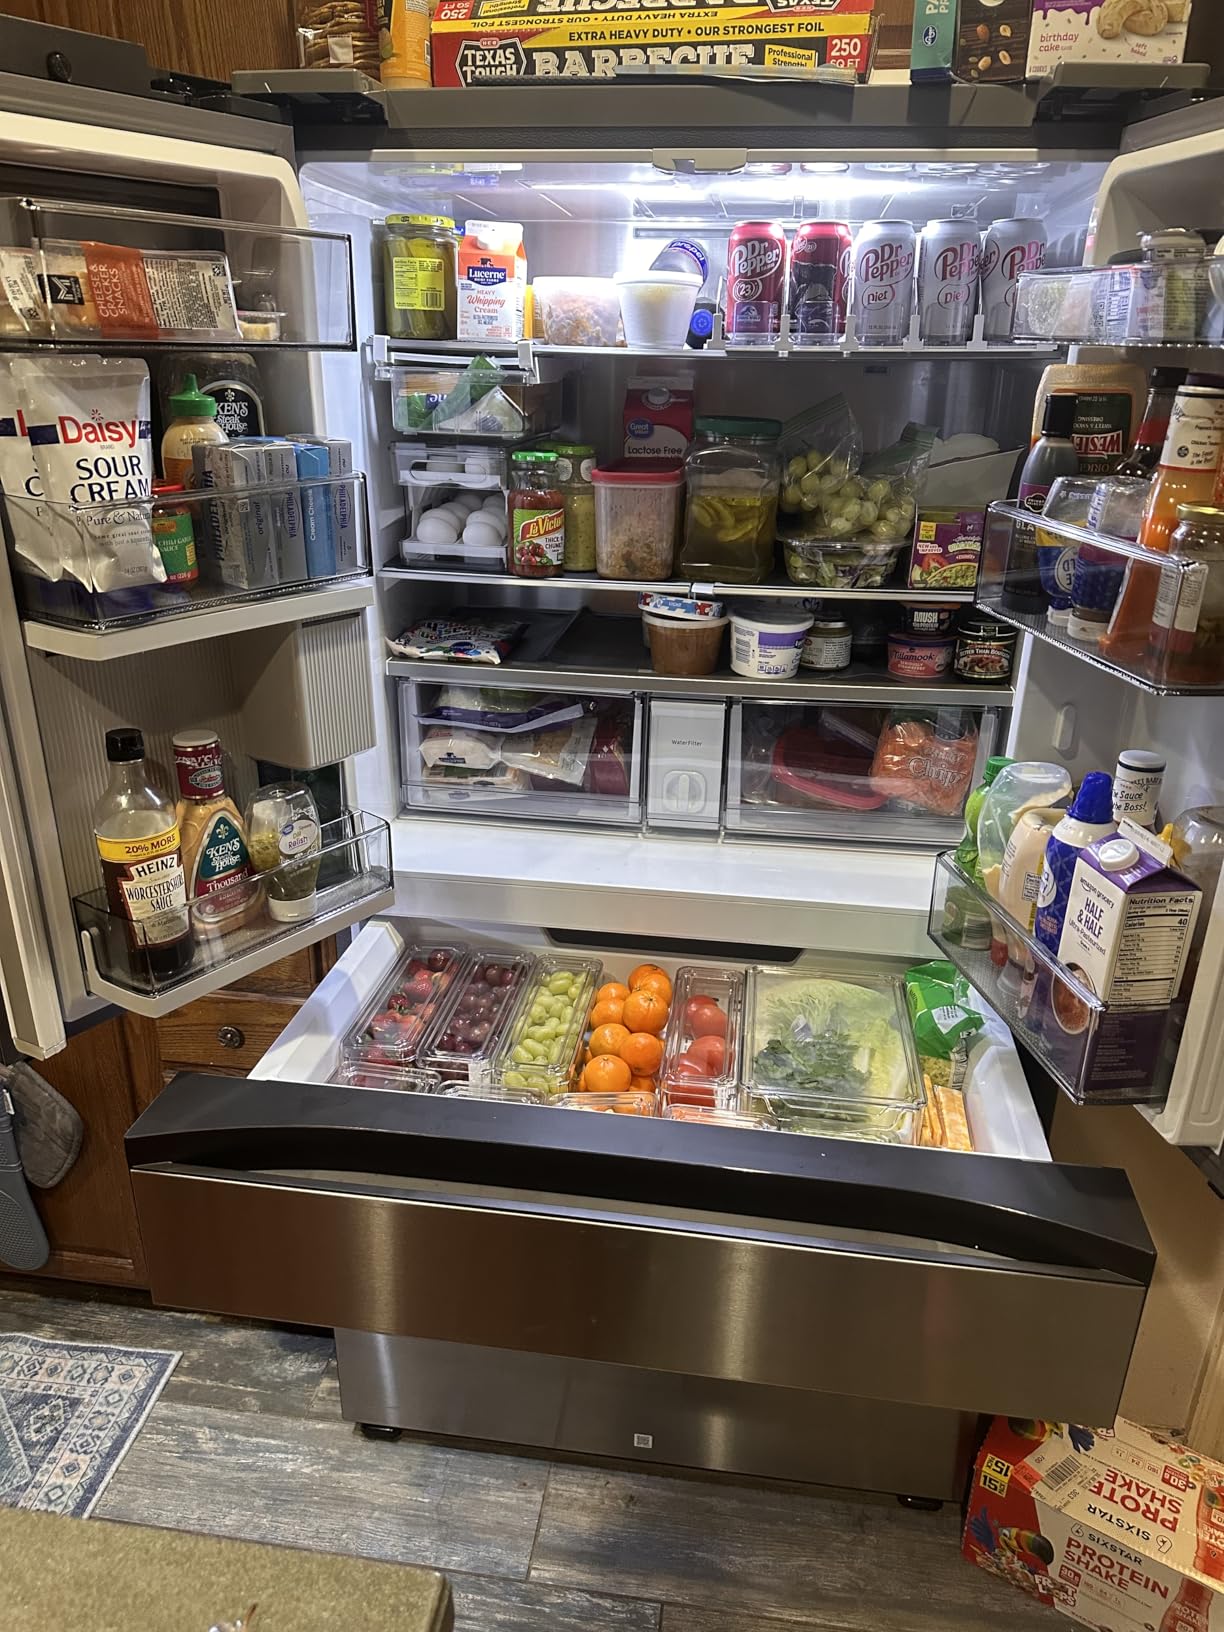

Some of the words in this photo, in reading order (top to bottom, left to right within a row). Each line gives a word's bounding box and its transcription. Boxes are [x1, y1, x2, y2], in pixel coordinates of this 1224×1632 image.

[441, 10, 466, 20] 250
[496, 17, 564, 26] STRONGEST
[601, 14, 633, 22] DUTY
[636, 12, 677, 20] HEAVY
[684, 10, 718, 18] EXTRA
[471, 20, 495, 28] FOIL
[569, 31, 607, 41] EXTRA
[609, 29, 649, 40] HEAVY
[652, 27, 684, 38] DUTY
[695, 26, 720, 36] OUR
[722, 22, 795, 36] STRONGEST
[797, 21, 825, 32] FOIL
[1040, 32, 1079, 43] birthday
[768, 47, 813, 61] Professional
[831, 38, 861, 56] 250
[1039, 43, 1060, 52] cake
[464, 48, 516, 66] TEXAS
[848, 58, 861, 68] FT
[672, 241, 705, 261] propel
[747, 240, 768, 260] Dr
[880, 243, 903, 263] Dr
[959, 241, 978, 262] Dr
[1027, 240, 1045, 259] Dr
[89, 263, 99, 272] &
[733, 245, 780, 277] Pepper
[864, 248, 912, 283] Pepper
[468, 268, 506, 280] Lucerne
[92, 273, 109, 317] CHEESE
[99, 264, 117, 318] CRACKER
[109, 268, 128, 315] SNACKS
[740, 281, 751, 296] 23
[867, 290, 888, 305] Diet
[944, 290, 965, 304] Diet
[466, 295, 506, 308] Whipping
[474, 306, 498, 314] Cream
[216, 402, 248, 417] KEN'S
[217, 414, 241, 424] Steak
[221, 422, 248, 434] House
[630, 422, 649, 430] Great
[58, 415, 137, 448] Daisy
[628, 446, 662, 455] Lactose
[664, 446, 682, 455] Free
[1072, 431, 1121, 453] WESTE
[76, 455, 144, 481] SOUR
[70, 478, 150, 503] CREAM
[285, 491, 297, 539] PHILADELPHIA
[339, 484, 348, 529] PHILADELPHIA
[87, 515, 111, 526] Pure
[113, 511, 124, 524] &
[914, 612, 939, 623] MUSH
[893, 651, 935, 662] Tillamook
[1120, 790, 1143, 800] Sauce
[1124, 802, 1147, 812] Boss!
[125, 844, 150, 854] 20%
[150, 833, 176, 850] MORE
[206, 838, 240, 858] KEN'S
[288, 836, 308, 850] Relish
[136, 857, 175, 878] HEINZ
[212, 852, 234, 866] Steak
[215, 854, 241, 872] House
[126, 871, 184, 901] WORCESTERSHIRE
[206, 868, 249, 892] Thousand
[1079, 877, 1098, 894] amazon
[1096, 890, 1115, 909] grocery
[151, 893, 173, 912] SAUCE
[1084, 897, 1104, 921] HALF
[1077, 909, 1084, 924] &
[1083, 916, 1104, 940] HALF
[1178, 918, 1188, 926] 40
[1068, 918, 1106, 956] Ultra-Pasteurized
[992, 1460, 1011, 1478] 15
[982, 1474, 999, 1492] 15
[1170, 1475, 1187, 1489] 30
[1104, 1469, 1184, 1514] SHAKE
[1088, 1481, 1179, 1532] PROTE
[1086, 1503, 1152, 1541] SIXSTAR
[1088, 1533, 1142, 1566] SIXSTAR
[1060, 1566, 1074, 1579] 30
[1064, 1550, 1130, 1591] SHAKE
[1066, 1536, 1170, 1600] PROTEIN
